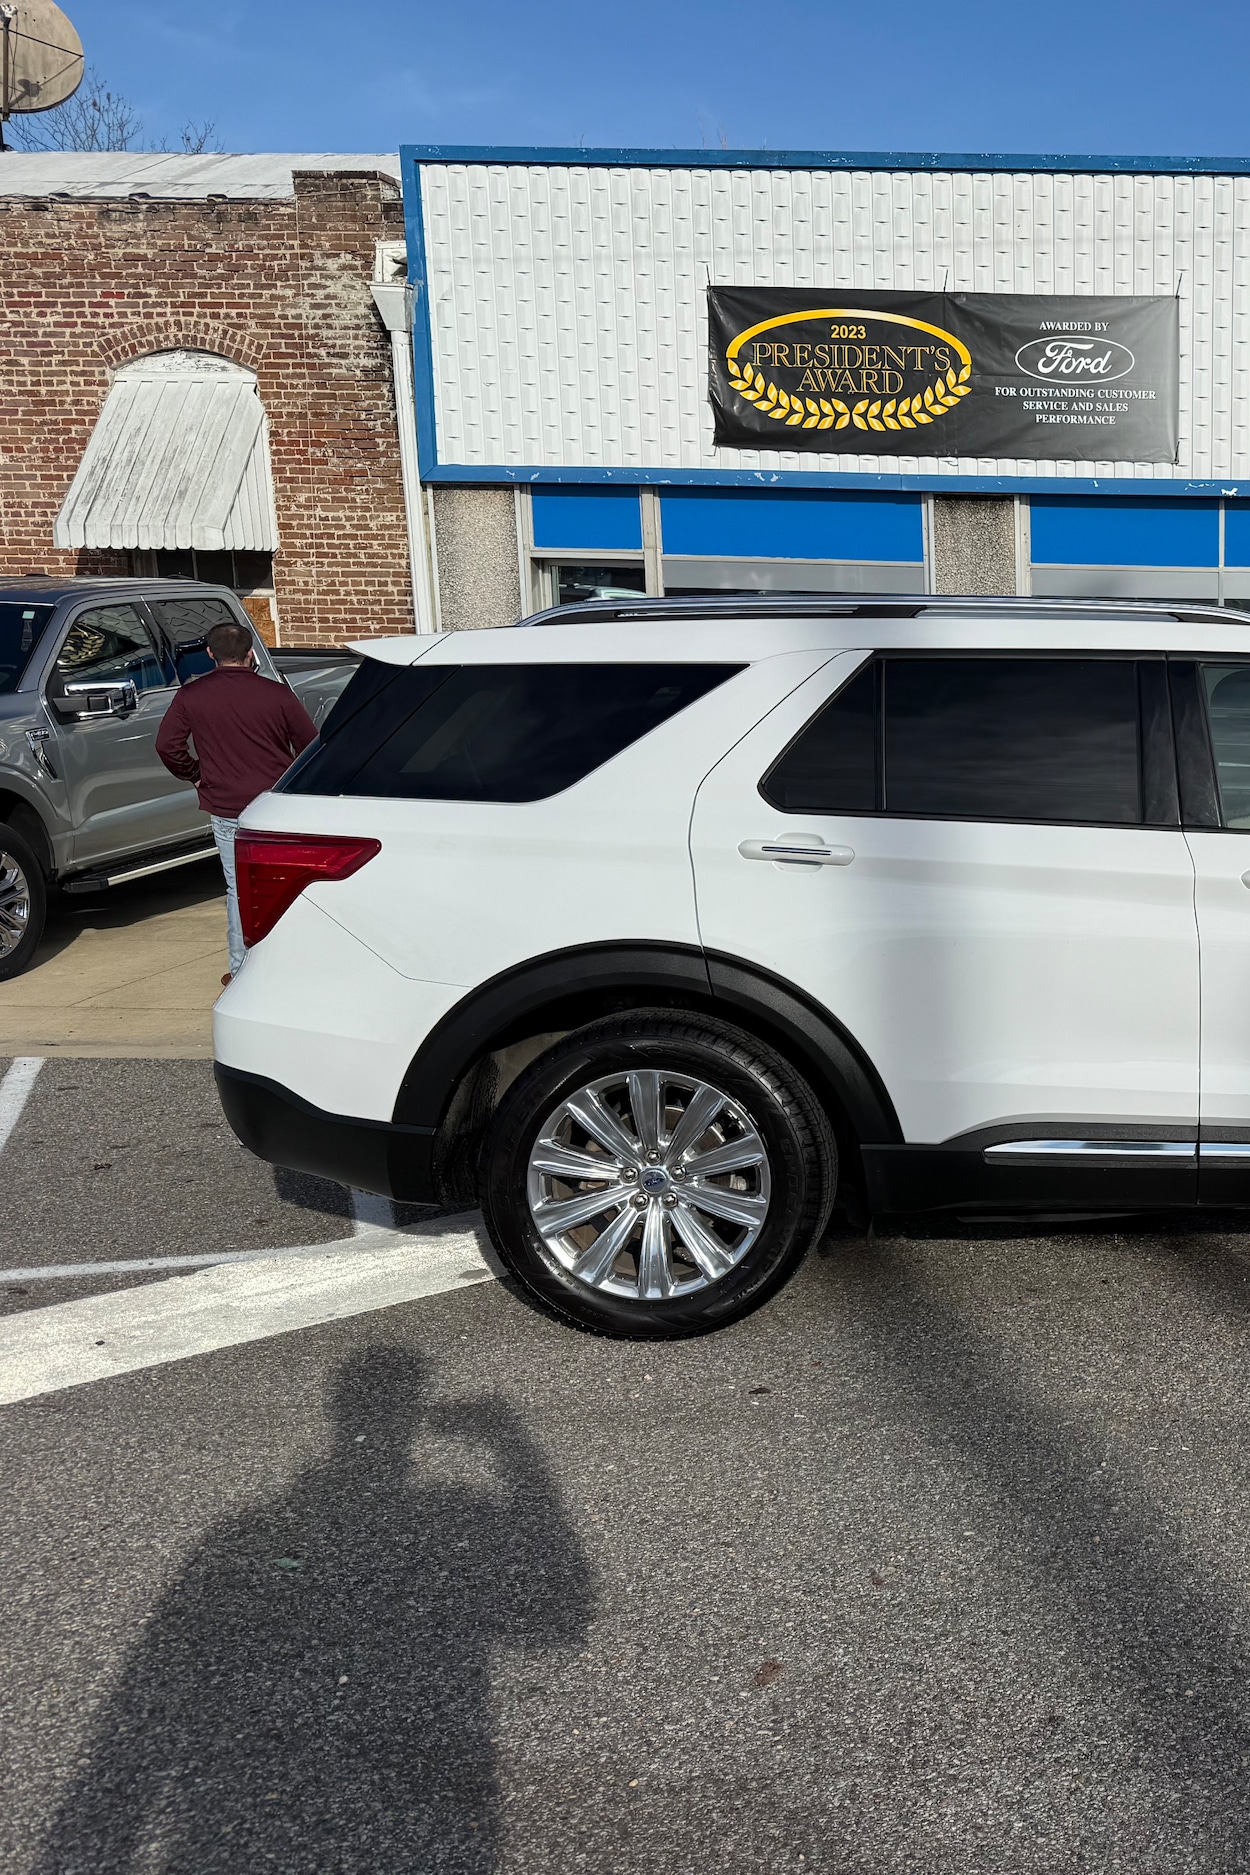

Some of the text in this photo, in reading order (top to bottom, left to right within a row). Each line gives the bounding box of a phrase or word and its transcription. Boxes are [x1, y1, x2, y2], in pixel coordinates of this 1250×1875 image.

[830, 324, 867, 340] 2023
[1039, 321, 1109, 331] AWARDED BY
[751, 342, 951, 372] PRESIDENT'S
[1037, 341, 1113, 374] Ford
[795, 368, 904, 395] AWARD
[995, 386, 1156, 400] FOR OUTSTANDING CUSTOMER
[1022, 401, 1129, 412] SERVICE AND SALES
[1035, 413, 1117, 425] PERFORMANCE
